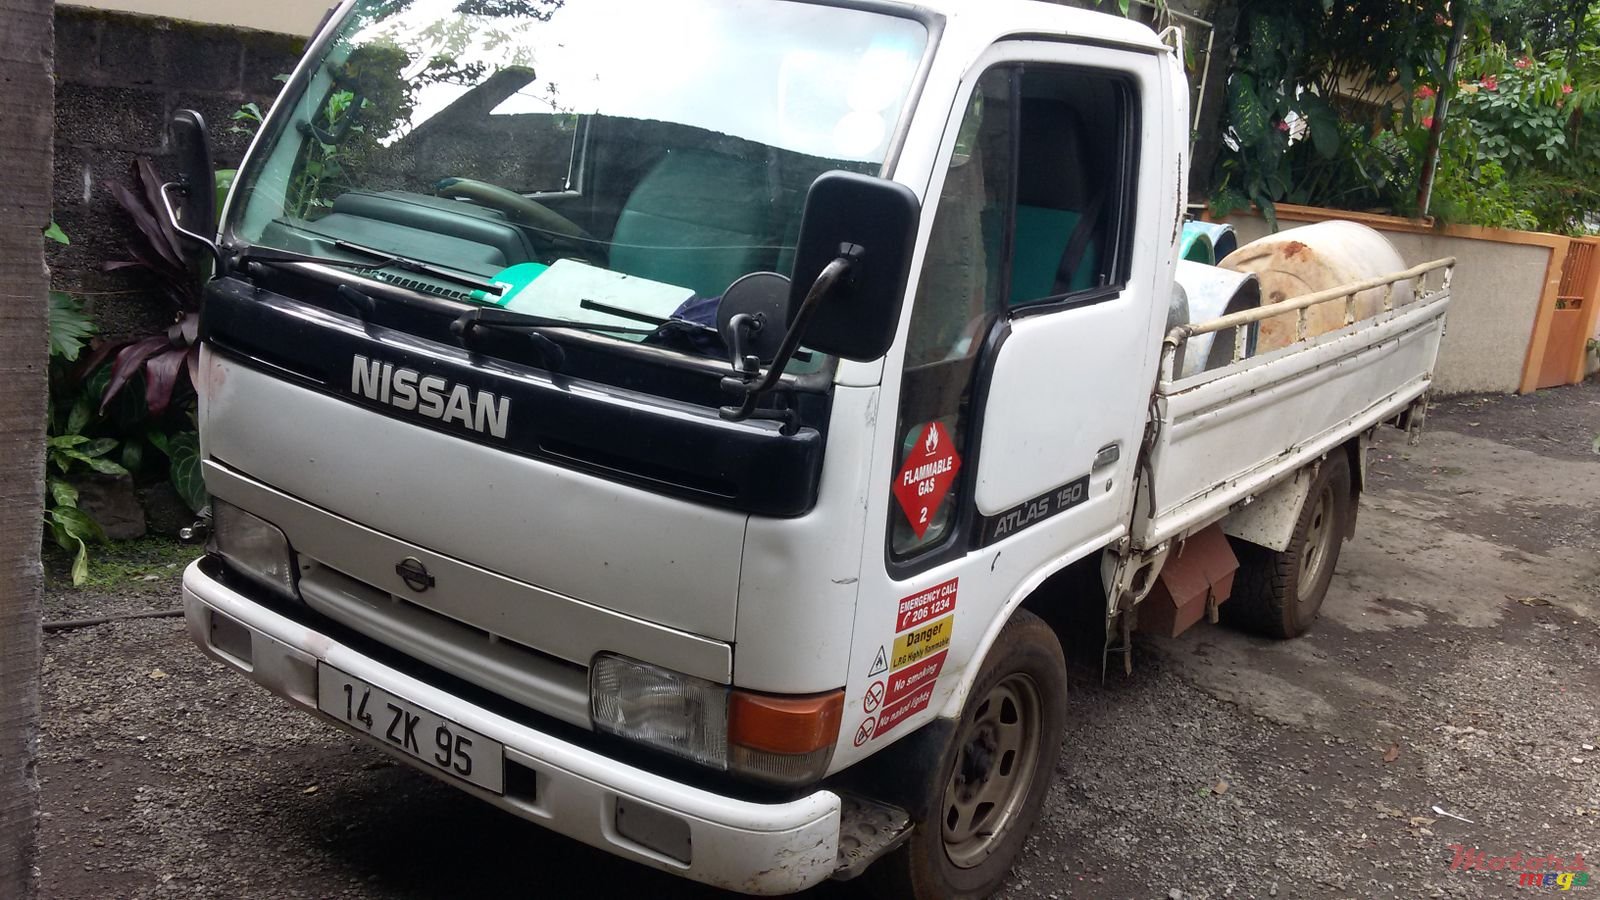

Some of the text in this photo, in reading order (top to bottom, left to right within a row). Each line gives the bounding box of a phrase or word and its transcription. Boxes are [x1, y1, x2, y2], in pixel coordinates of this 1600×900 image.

[352, 354, 511, 438] NISSAN
[903, 456, 953, 486] FLAMMABLE
[918, 478, 935, 496] GAS
[919, 507, 928, 523] 2
[994, 483, 1082, 538] ATLAS 150
[900, 582, 957, 613] EMERGENCY CALL
[912, 597, 950, 622] 206 1234
[906, 623, 943, 647] Danger
[908, 647, 924, 662] Highly
[894, 663, 937, 692] No smoking
[878, 691, 930, 728] No naked lights
[344, 684, 472, 776] 14 ZK 95
